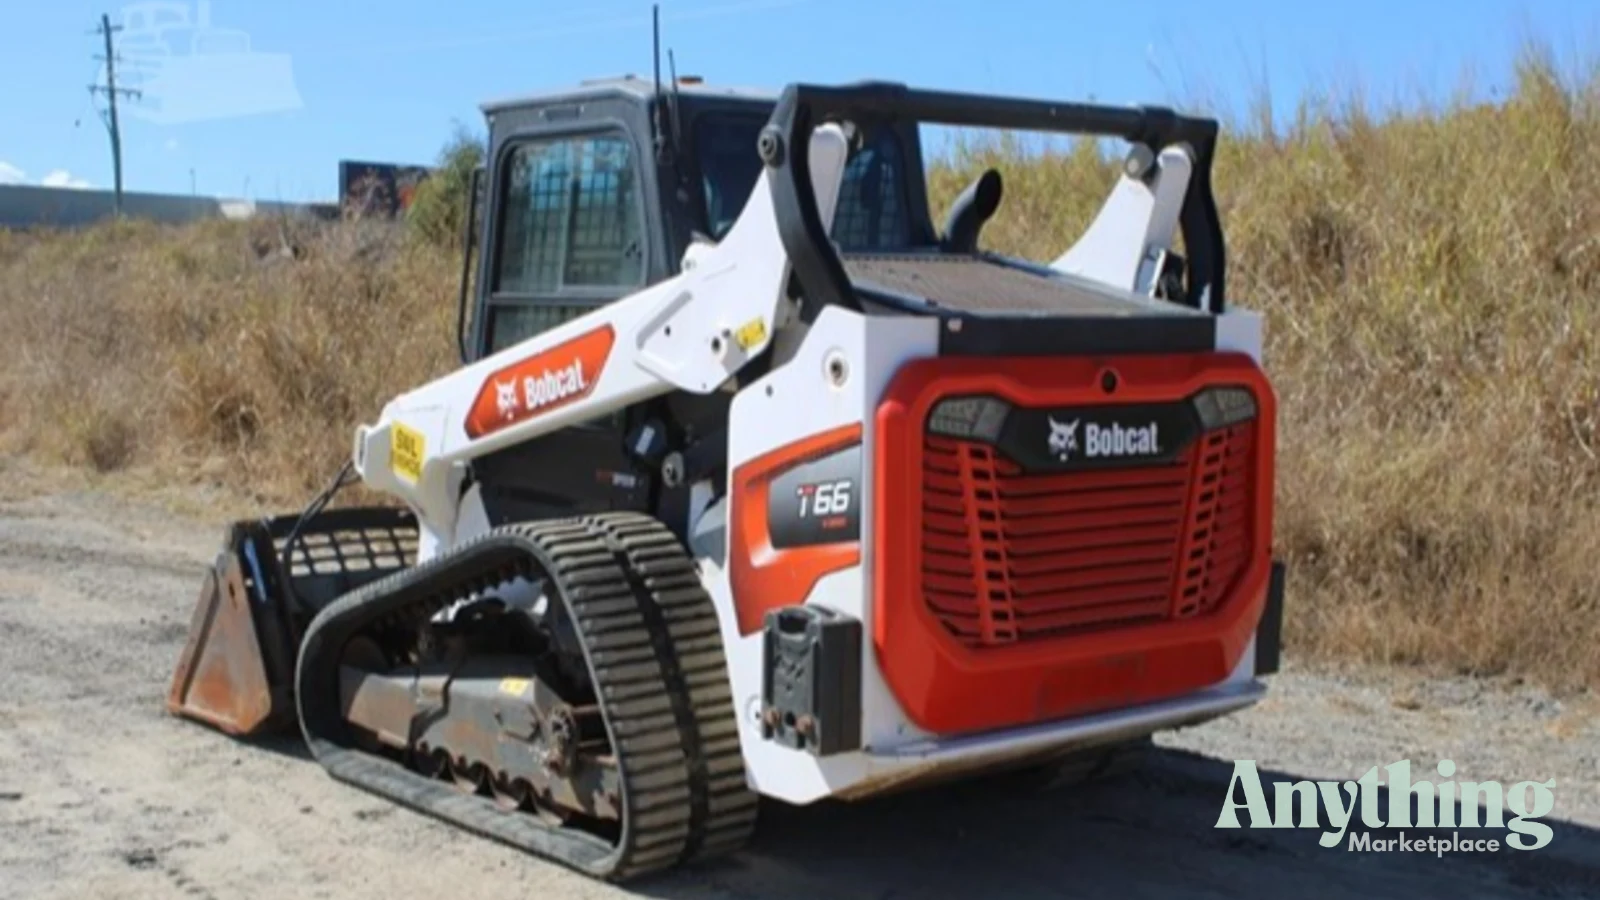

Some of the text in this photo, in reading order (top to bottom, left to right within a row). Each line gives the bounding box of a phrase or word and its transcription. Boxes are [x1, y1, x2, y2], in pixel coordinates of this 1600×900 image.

[523, 357, 585, 410] Bobcat
[1085, 418, 1158, 457] Bobcat
[797, 481, 852, 518] T66
